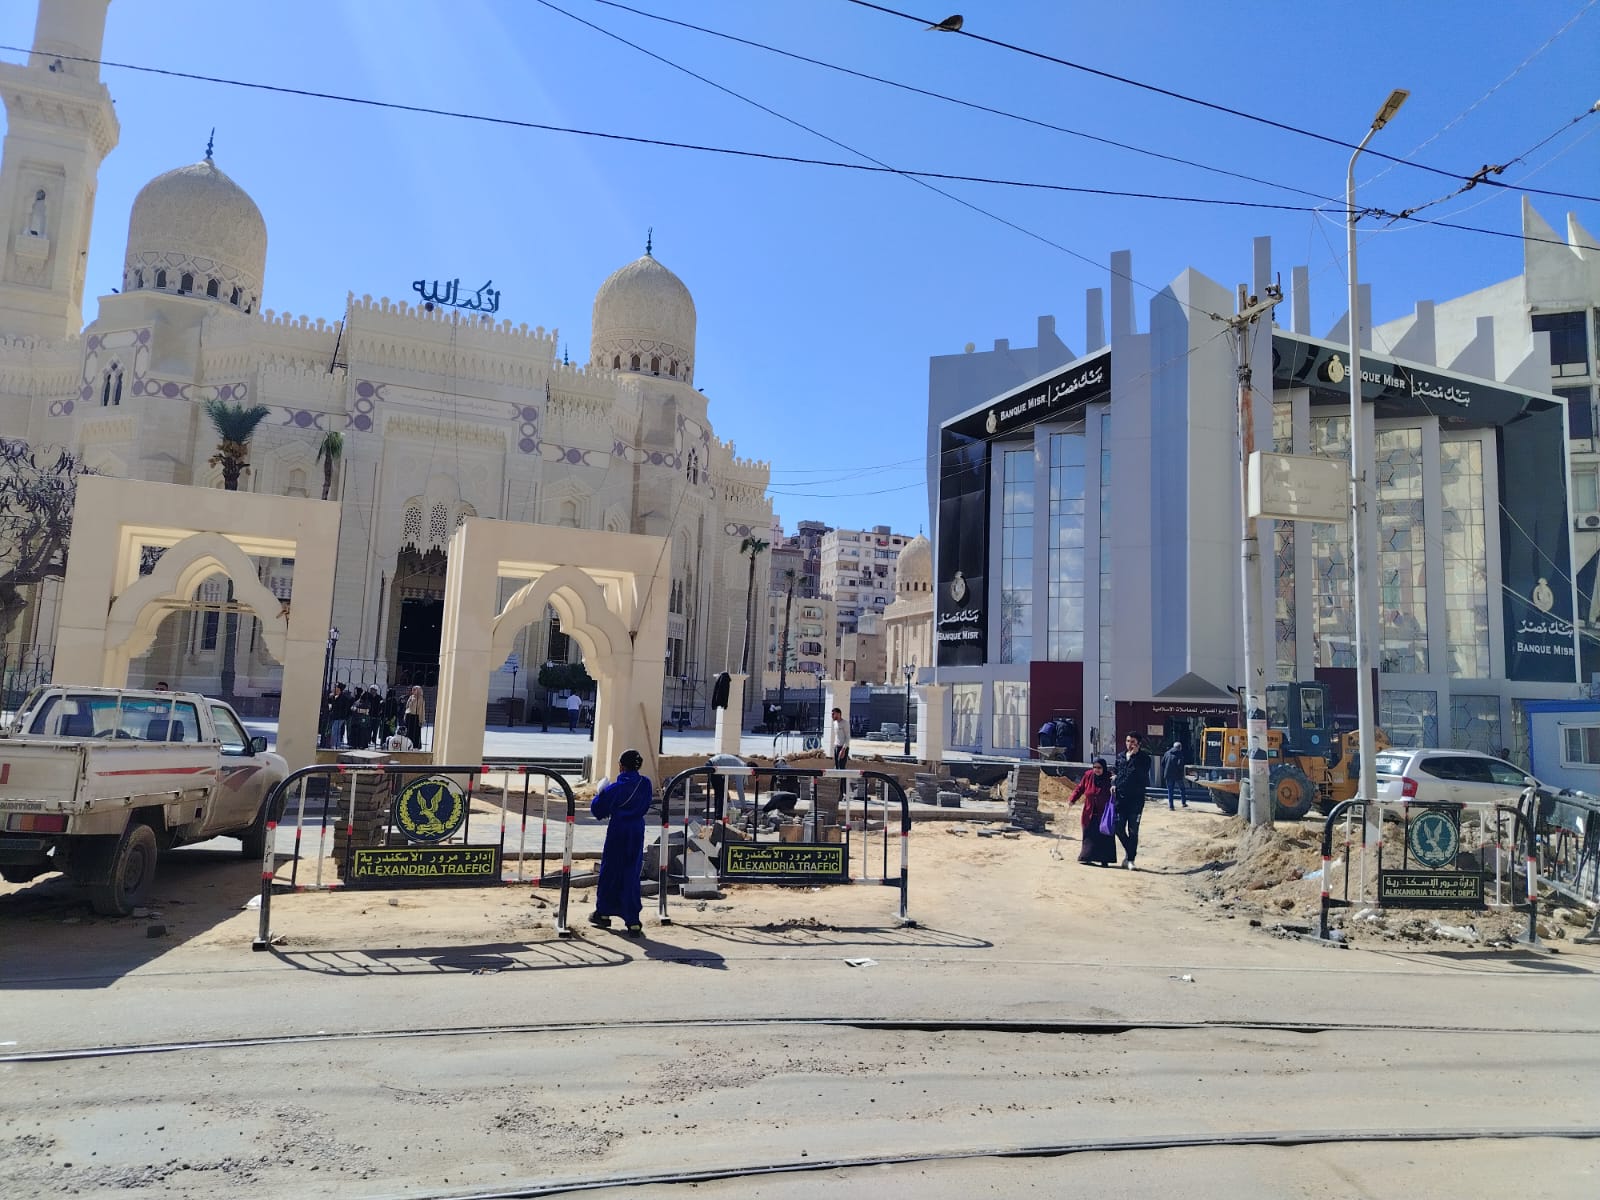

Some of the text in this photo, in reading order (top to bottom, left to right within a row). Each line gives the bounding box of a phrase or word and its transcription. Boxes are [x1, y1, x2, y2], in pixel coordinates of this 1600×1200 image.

[412, 278, 460, 305] الله
[1344, 365, 1381, 384] BQUE
[430, 853, 459, 864] مرور
[789, 852, 812, 861] مرور
[358, 863, 491, 876] ALEXANDRIA TRAFFIC
[732, 861, 839, 871] ALEXANDRIA TRAFFIC
[1440, 879, 1458, 889] مرور
[1385, 888, 1428, 896] ALEXANDRIA
[1429, 889, 1456, 897] TRAFFIC
